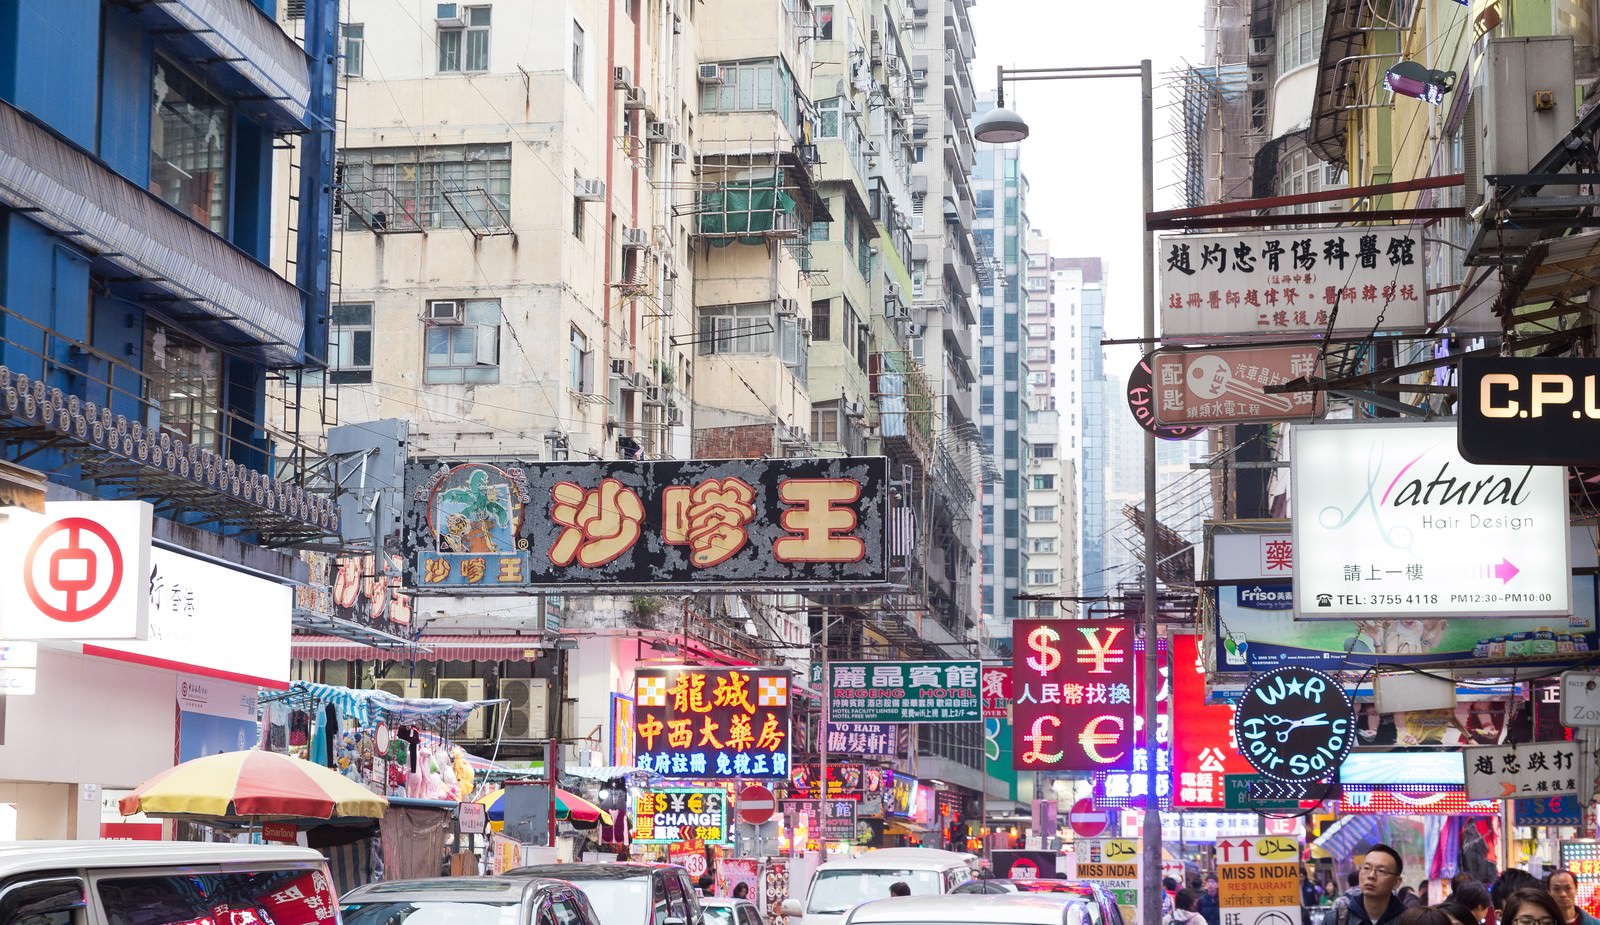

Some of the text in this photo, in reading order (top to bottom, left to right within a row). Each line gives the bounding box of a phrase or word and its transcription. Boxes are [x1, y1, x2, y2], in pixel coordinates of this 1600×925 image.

[1209, 364, 1227, 395] KEY
[549, 477, 866, 567] 沙嗲王
[1422, 513, 1534, 530] Hair Design
[1344, 563, 1424, 582] 請上一樓
[1242, 586, 1277, 600] Friso
[1337, 594, 1367, 605] TEL:
[1370, 594, 1402, 605] 3755
[1406, 593, 1438, 604] 4118
[834, 666, 978, 688] 麗晶賓館
[667, 671, 756, 715] 龍城
[834, 688, 976, 699] REGENG HOTEL
[1017, 683, 1131, 705] 人民幣找換
[637, 713, 785, 752] 中西大藥房
[854, 724, 880, 732] HAIR
[1243, 718, 1284, 770] Hair
[1288, 718, 1347, 775] Salon
[1474, 750, 1574, 775] 趙忠跌打
[654, 813, 721, 826] CHANGE
[1259, 840, 1297, 857] حلال
[1078, 864, 1136, 877] MISS INDIA
[1222, 865, 1298, 879] MISS INDIA
[1228, 881, 1293, 891] RESTAURANT
